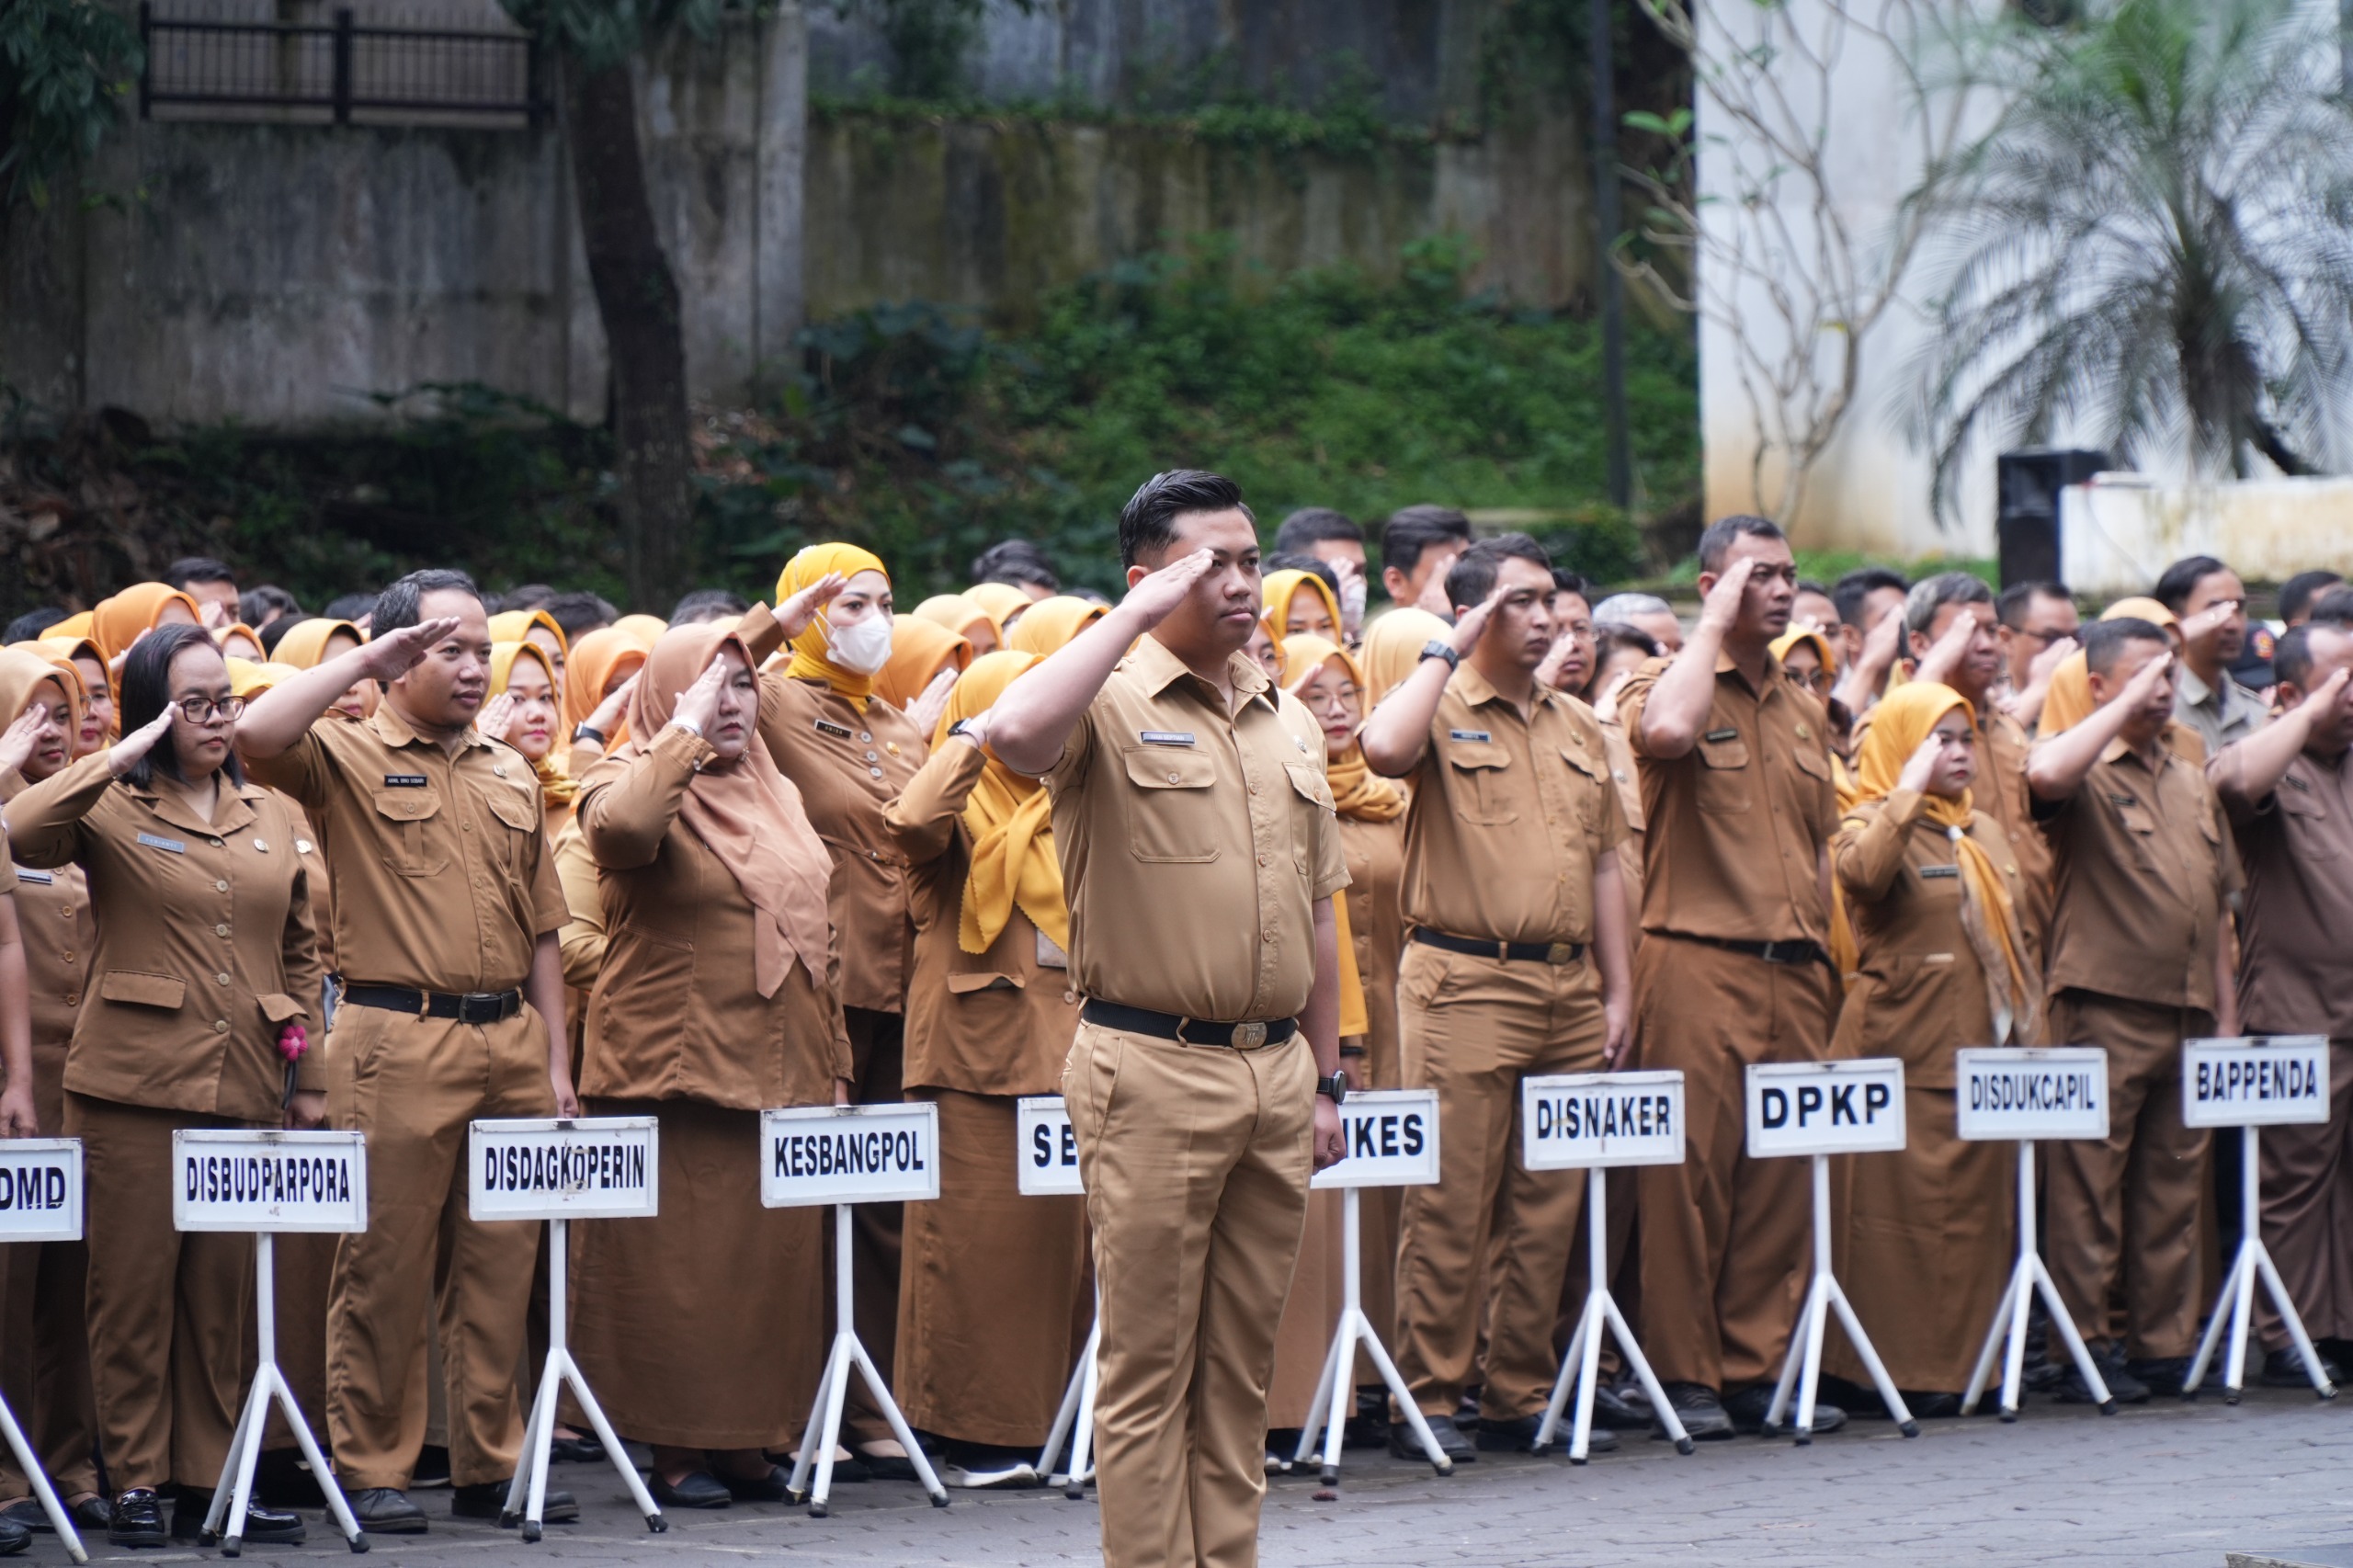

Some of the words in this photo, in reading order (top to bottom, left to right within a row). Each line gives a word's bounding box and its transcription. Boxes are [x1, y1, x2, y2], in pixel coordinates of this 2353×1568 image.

[1972, 1074, 2095, 1110] DISDUKCAPIL
[2198, 1060, 2316, 1101] BAPPENDA
[1537, 1096, 1670, 1139] DISNAKER
[1761, 1083, 1890, 1129] DPKP
[485, 1144, 644, 1191] DISDAGKOPERIN
[775, 1131, 924, 1177] KESBANGPOL
[187, 1156, 350, 1203] DISBUDPARPORA
